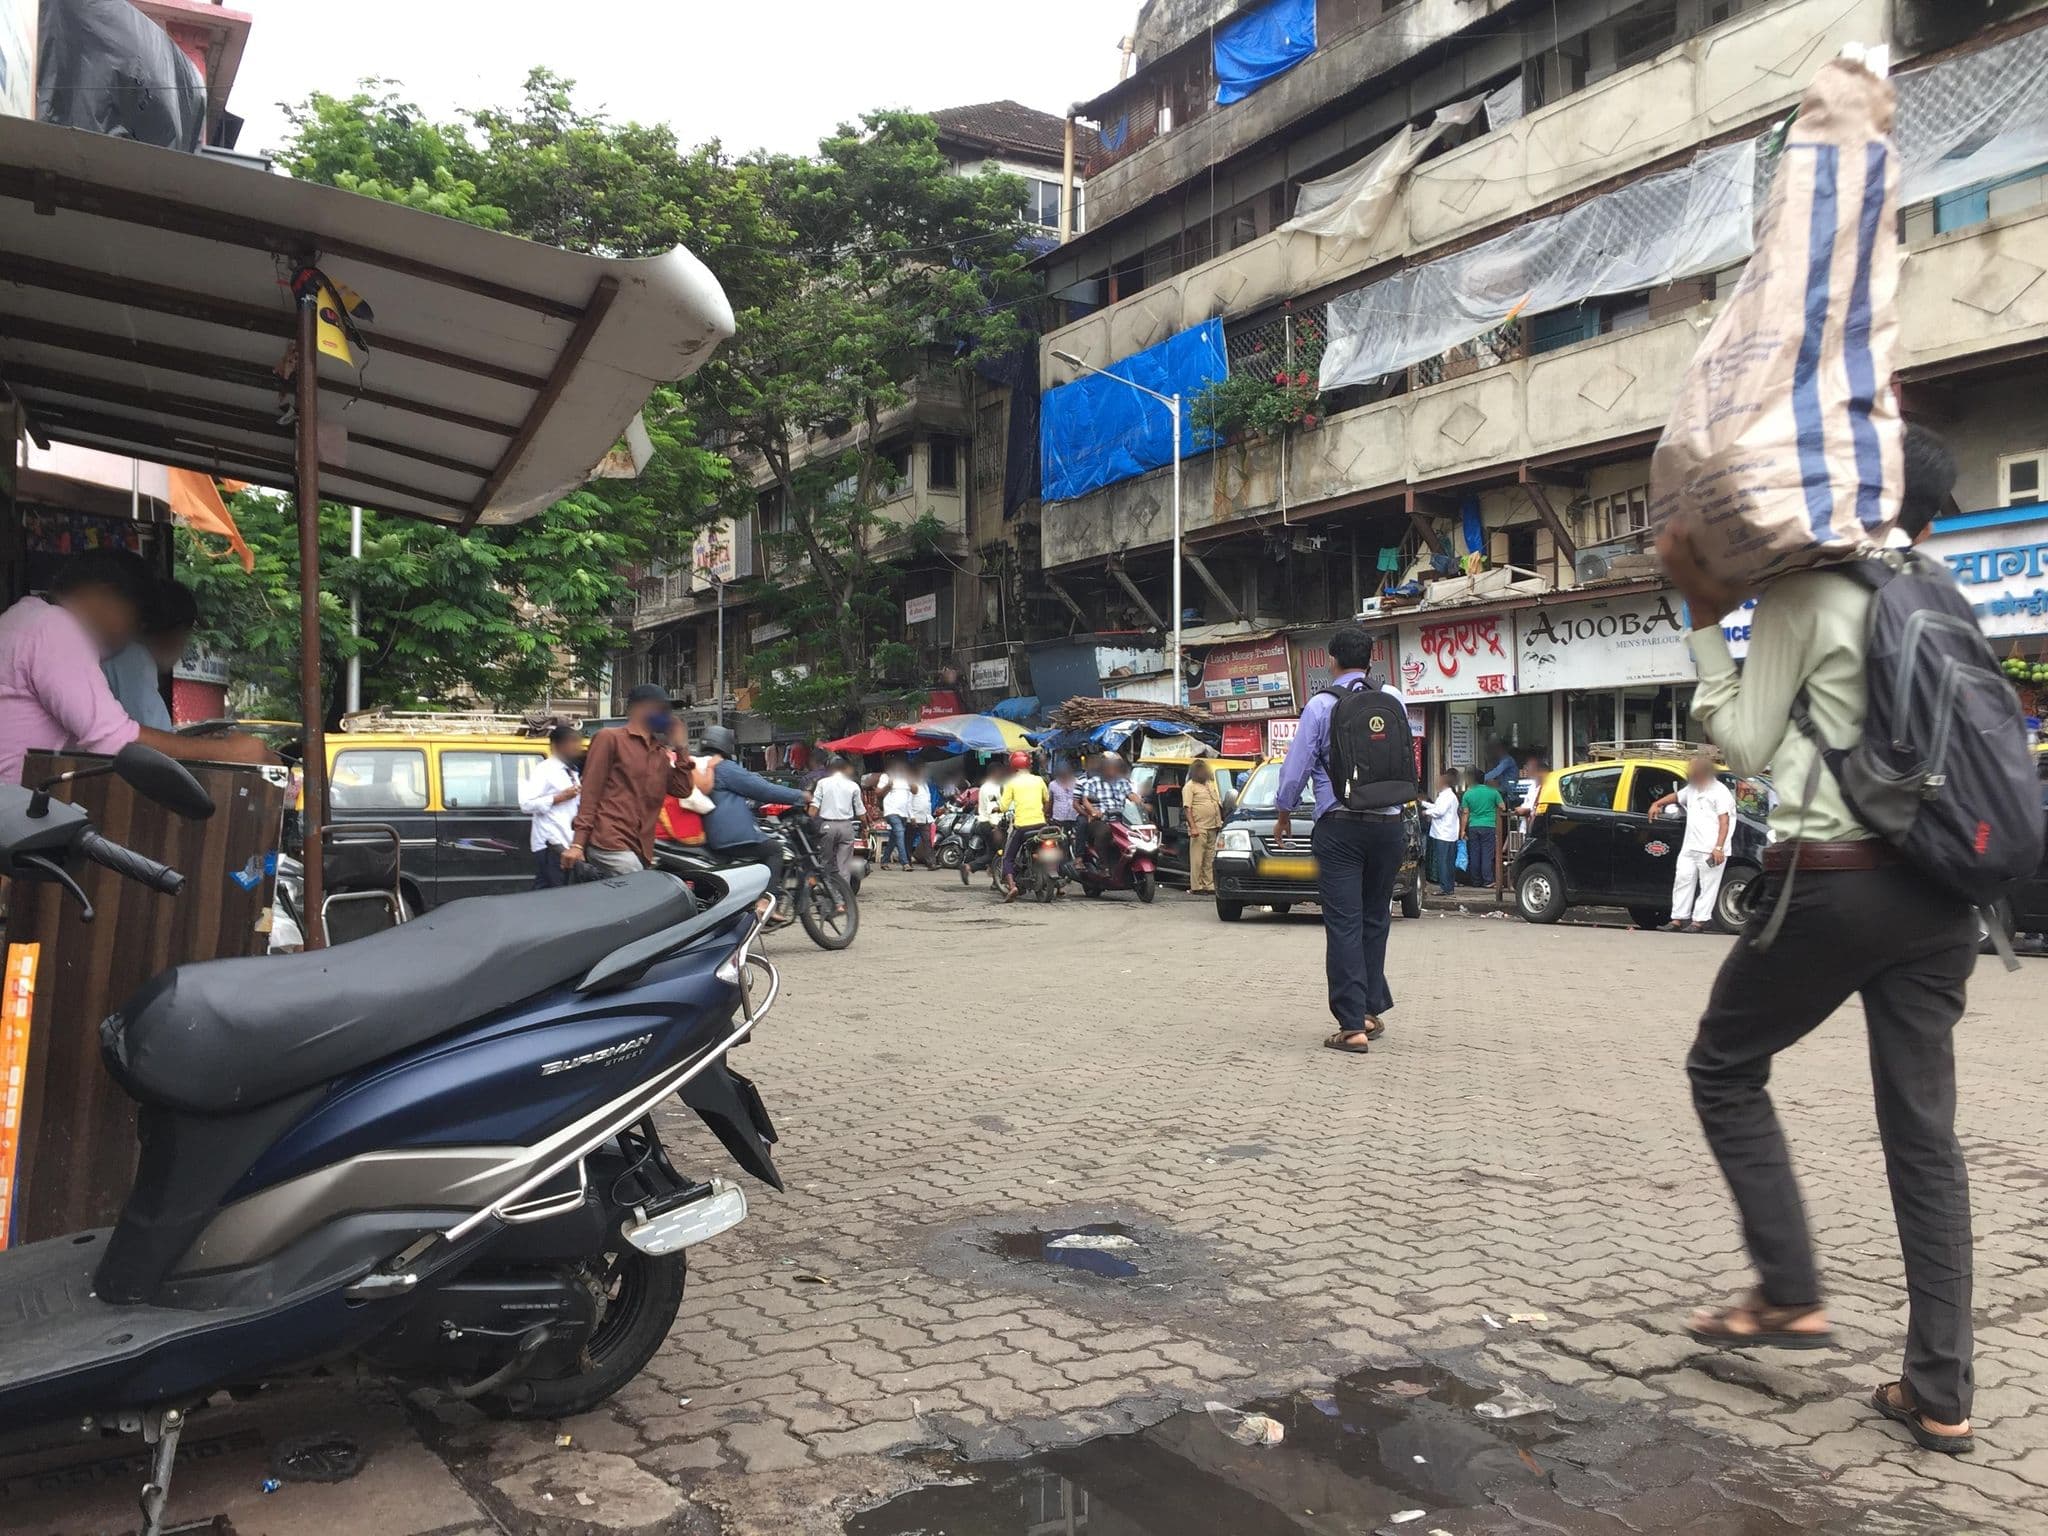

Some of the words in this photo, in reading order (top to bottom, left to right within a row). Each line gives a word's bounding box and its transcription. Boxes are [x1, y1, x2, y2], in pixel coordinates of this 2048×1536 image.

[1943, 542, 2048, 584] साग
[1526, 595, 1683, 647] AJOOBA
[1419, 615, 1506, 678] महाराष्ट्र
[1616, 640, 1640, 648] MEN'S
[1642, 636, 1681, 647] PARLOUR
[1231, 651, 1254, 662] Money
[1255, 645, 1285, 659] Transfer
[1308, 647, 1325, 668] OLD
[1477, 674, 1507, 694] चहा
[1273, 723, 1290, 738] OLD
[541, 1033, 653, 1076] BURGMAN
[604, 1048, 645, 1067] STREET
